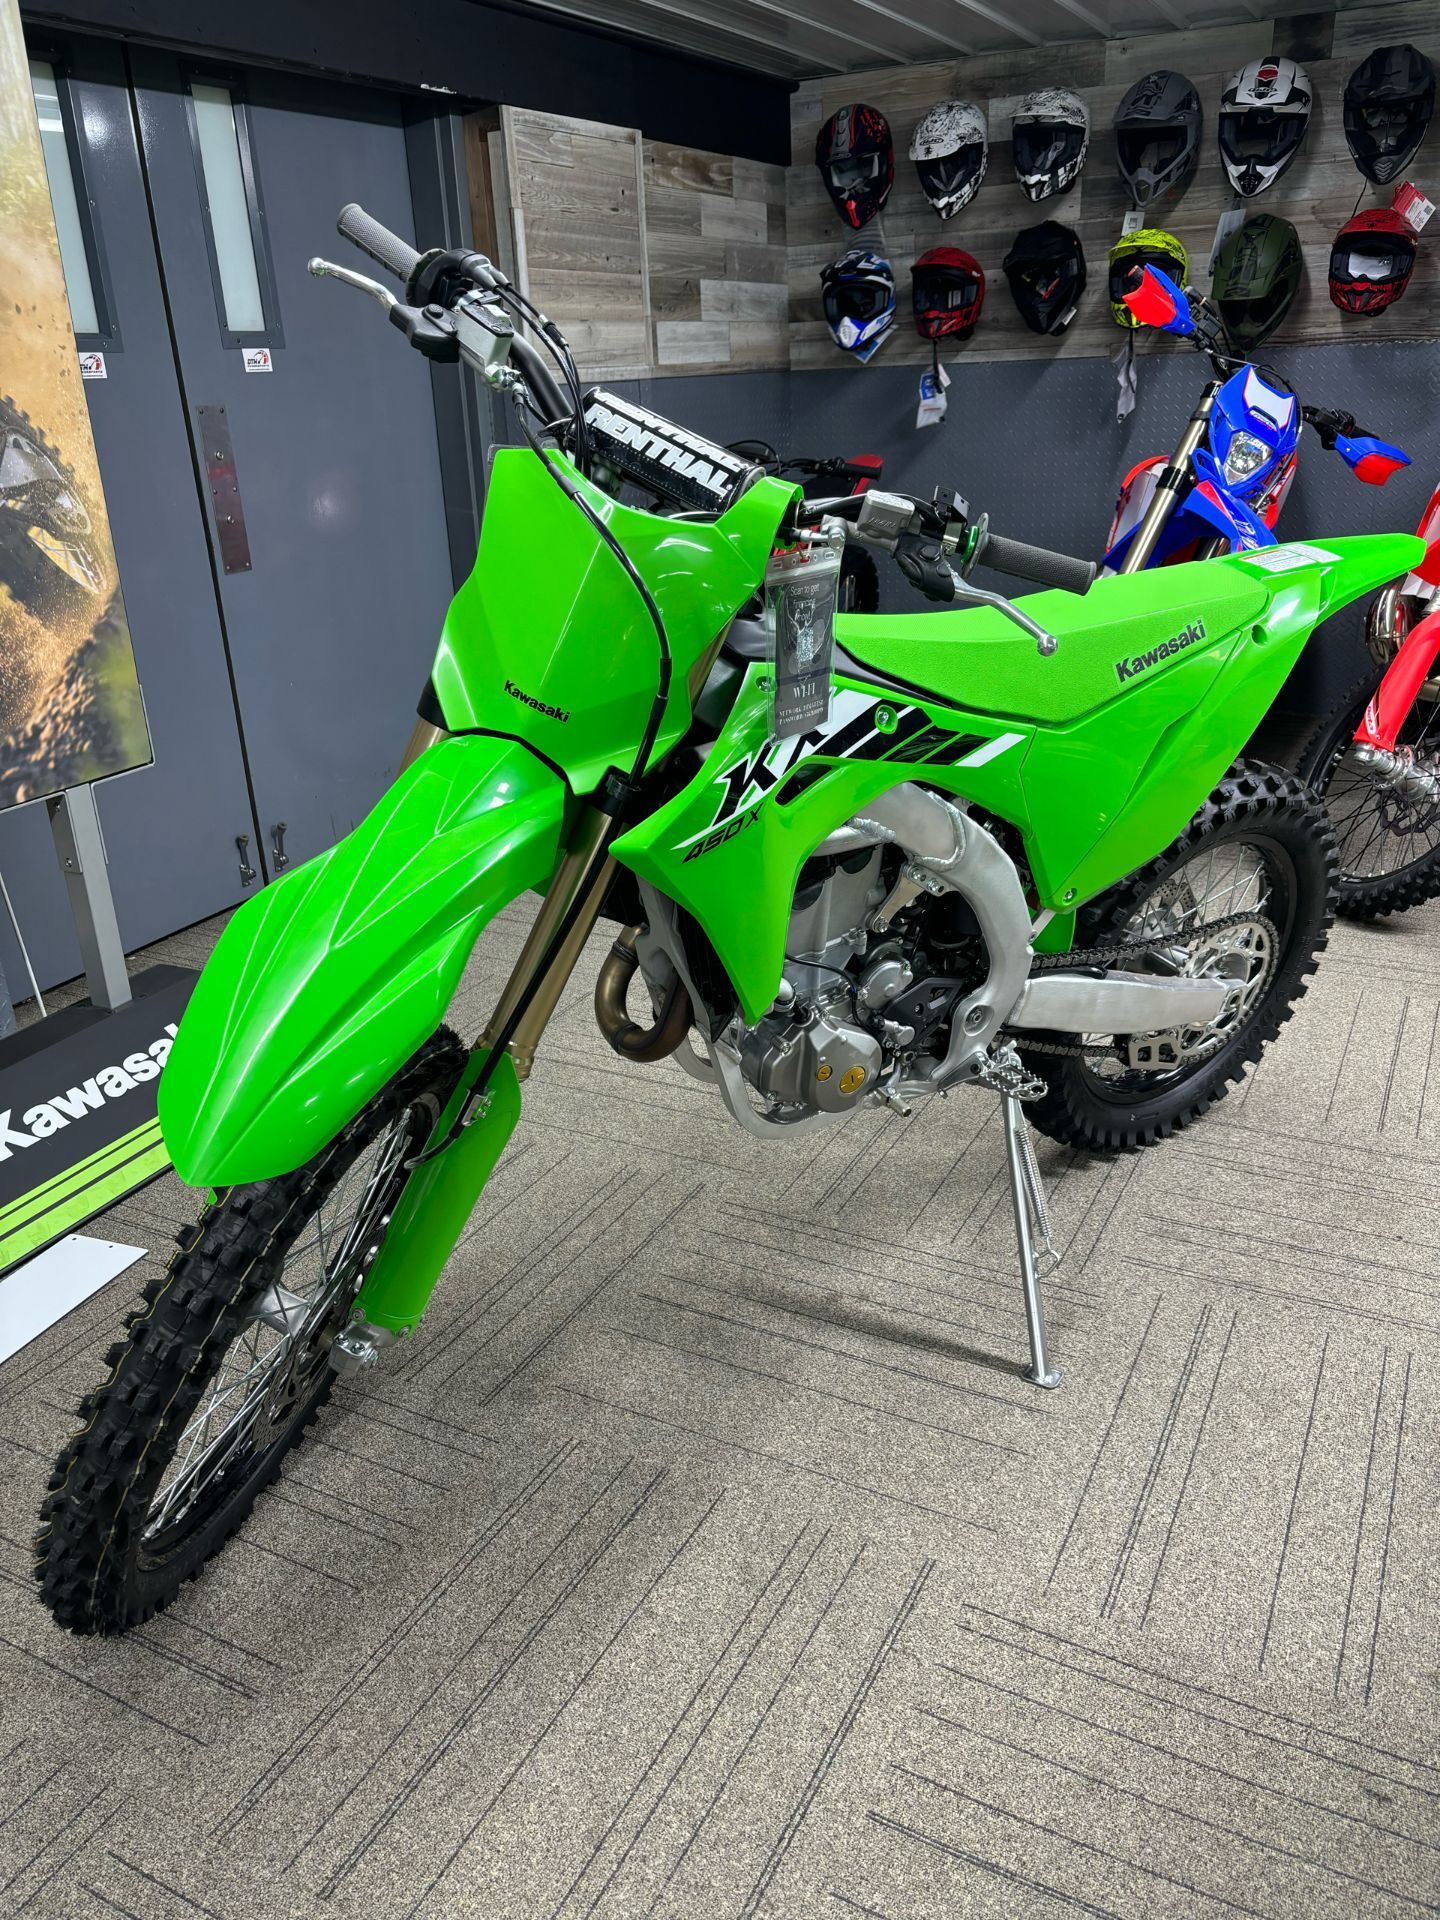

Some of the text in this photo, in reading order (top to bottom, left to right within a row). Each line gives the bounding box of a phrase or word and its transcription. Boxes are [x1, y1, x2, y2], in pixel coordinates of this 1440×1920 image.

[585, 403, 730, 498] RENTHAL
[791, 586, 803, 596] Scan
[1115, 619, 1206, 683] Kawasaki
[504, 679, 570, 722] Kawasaki
[0, 1022, 180, 1162] Kawasa
